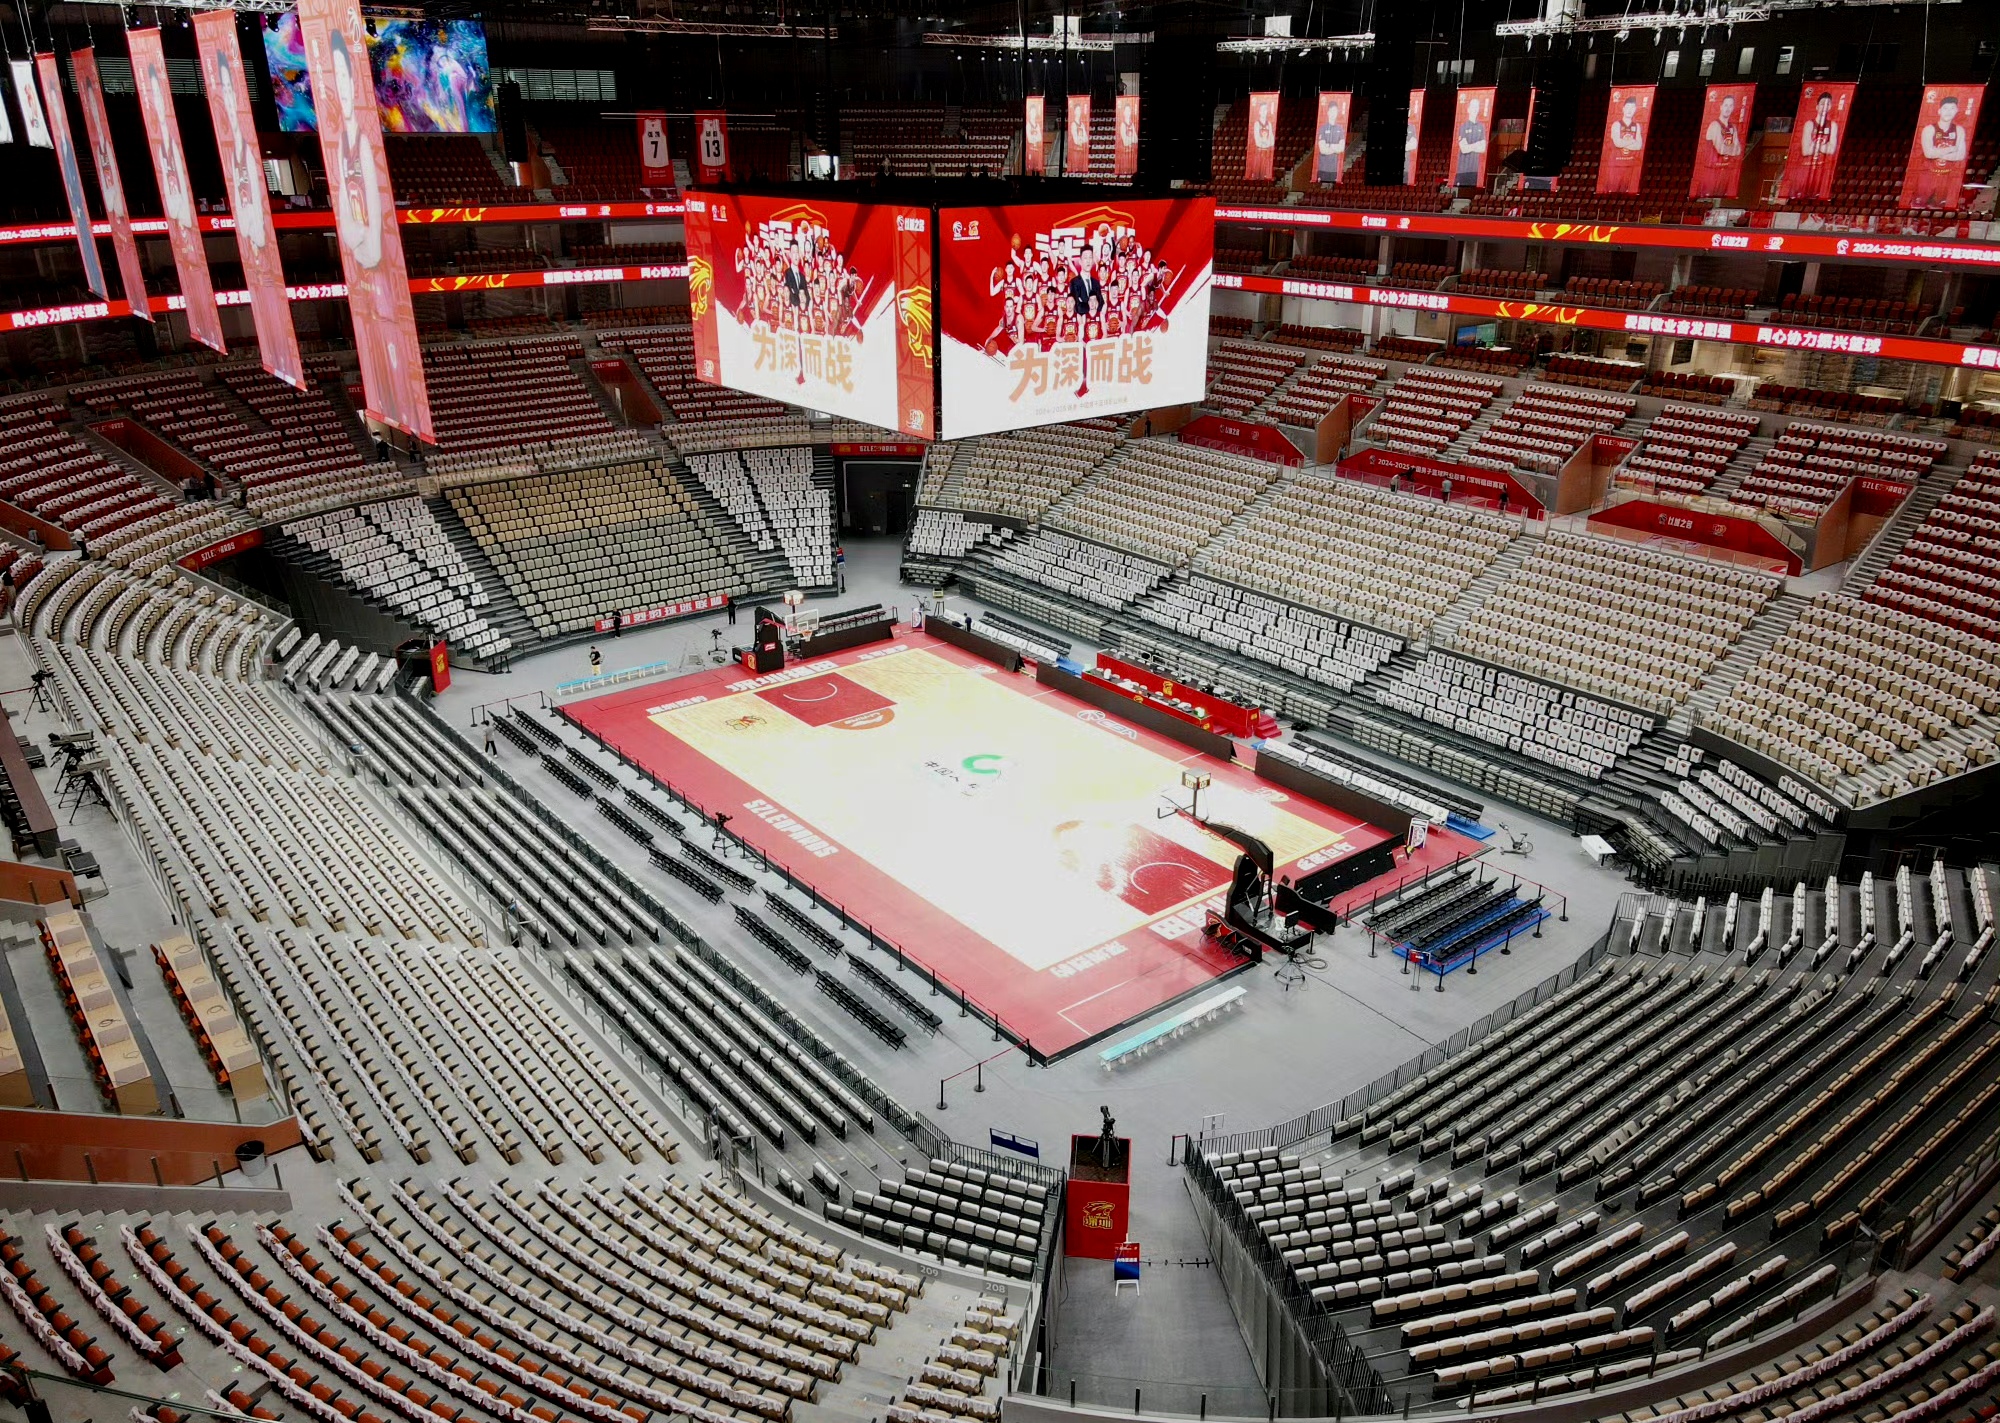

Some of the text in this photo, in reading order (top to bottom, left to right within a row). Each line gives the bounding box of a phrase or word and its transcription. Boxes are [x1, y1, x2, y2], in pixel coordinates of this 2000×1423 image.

[651, 141, 658, 158] 7
[705, 140, 720, 157] 13
[1757, 327, 1881, 353] 同心协力振兴篮球
[753, 325, 854, 394] 为深而战
[1961, 347, 2000, 367] 爱国
[1009, 335, 1153, 403] 为深而战
[920, 1265, 939, 1277] 209
[985, 1282, 1006, 1294] 208
